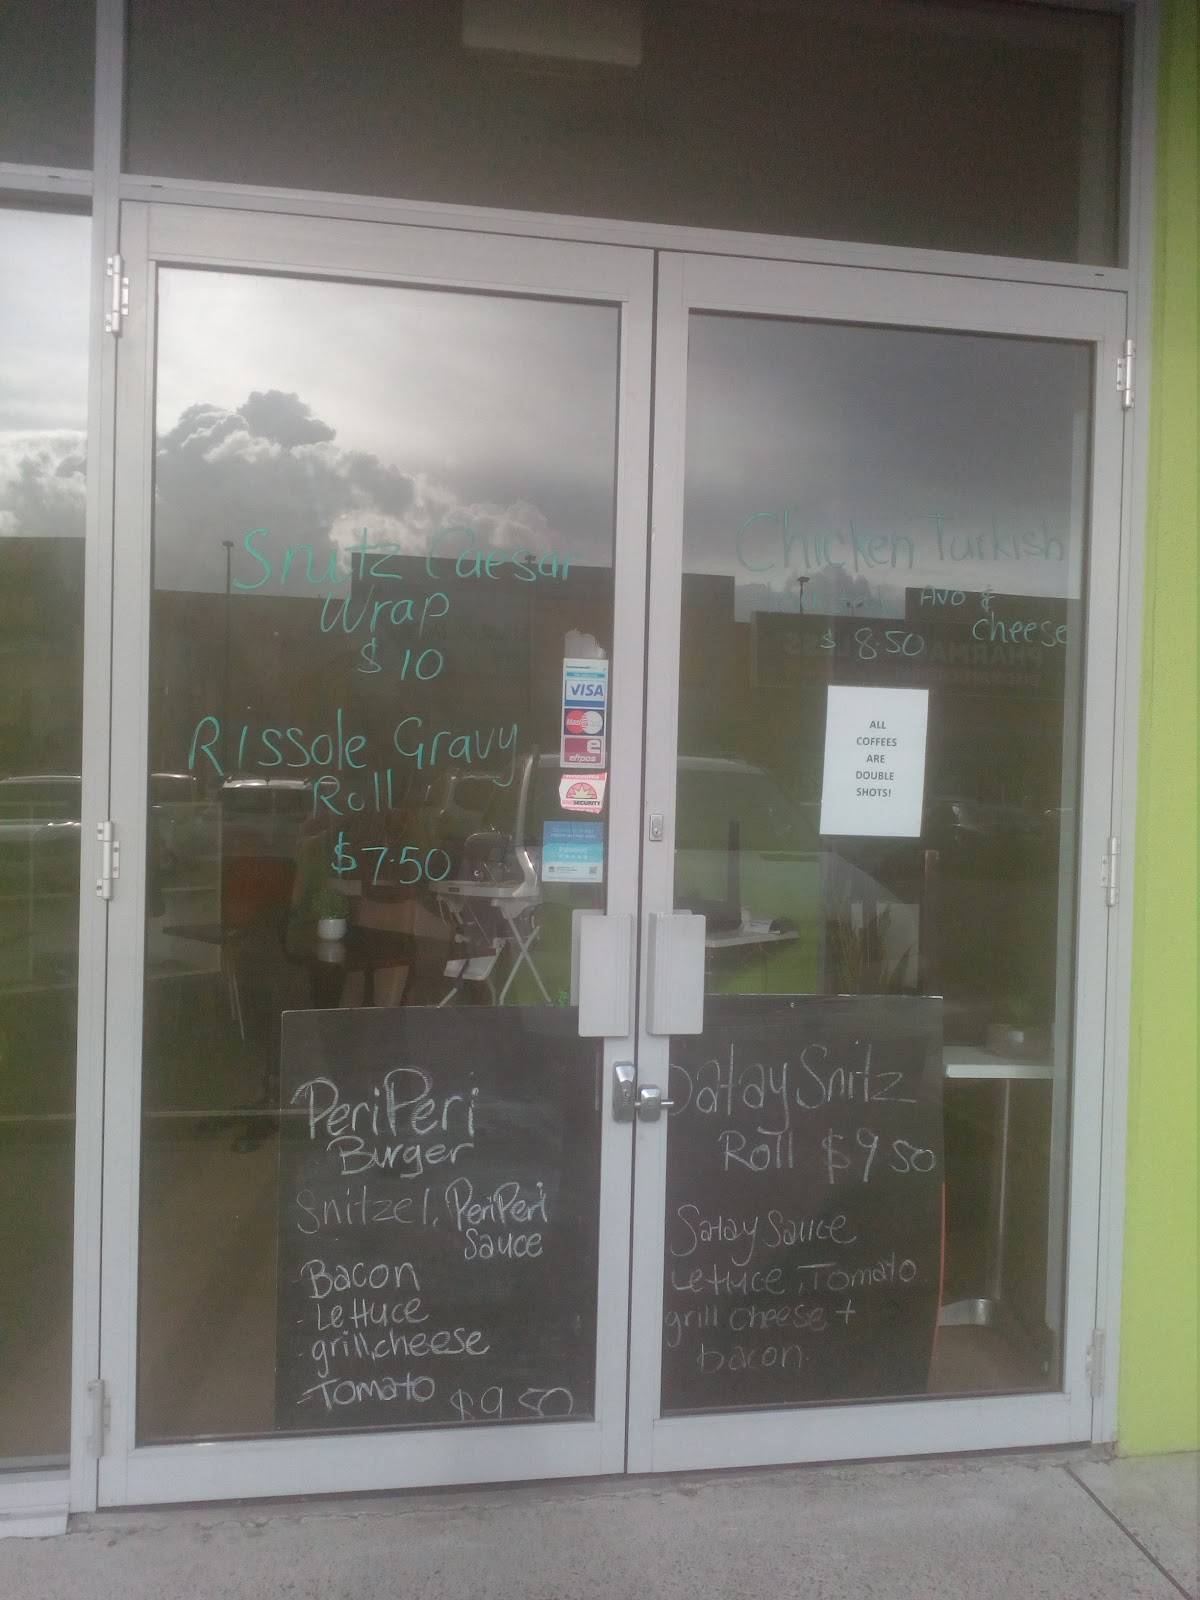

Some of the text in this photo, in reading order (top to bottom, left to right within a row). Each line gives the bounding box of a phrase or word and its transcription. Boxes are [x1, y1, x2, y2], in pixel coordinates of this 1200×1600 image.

[735, 509, 1066, 573] Chicken Turkish
[319, 586, 450, 637] Wrap
[972, 611, 1069, 647] cheese
[571, 683, 604, 697] VISA
[856, 736, 897, 747] COFFEES
[869, 720, 887, 730] ALL
[394, 716, 518, 787] Gravy
[866, 754, 886, 764] ARE
[313, 769, 394, 816] Roll
[855, 770, 895, 781] DOUBLE
[855, 787, 892, 798] SHOTS!
[326, 1135, 475, 1179] Burger
[718, 1130, 794, 1171] Roll
[670, 1203, 760, 1267] Satay
[300, 1259, 421, 1299] Bacon
[664, 1304, 719, 1348] grill
